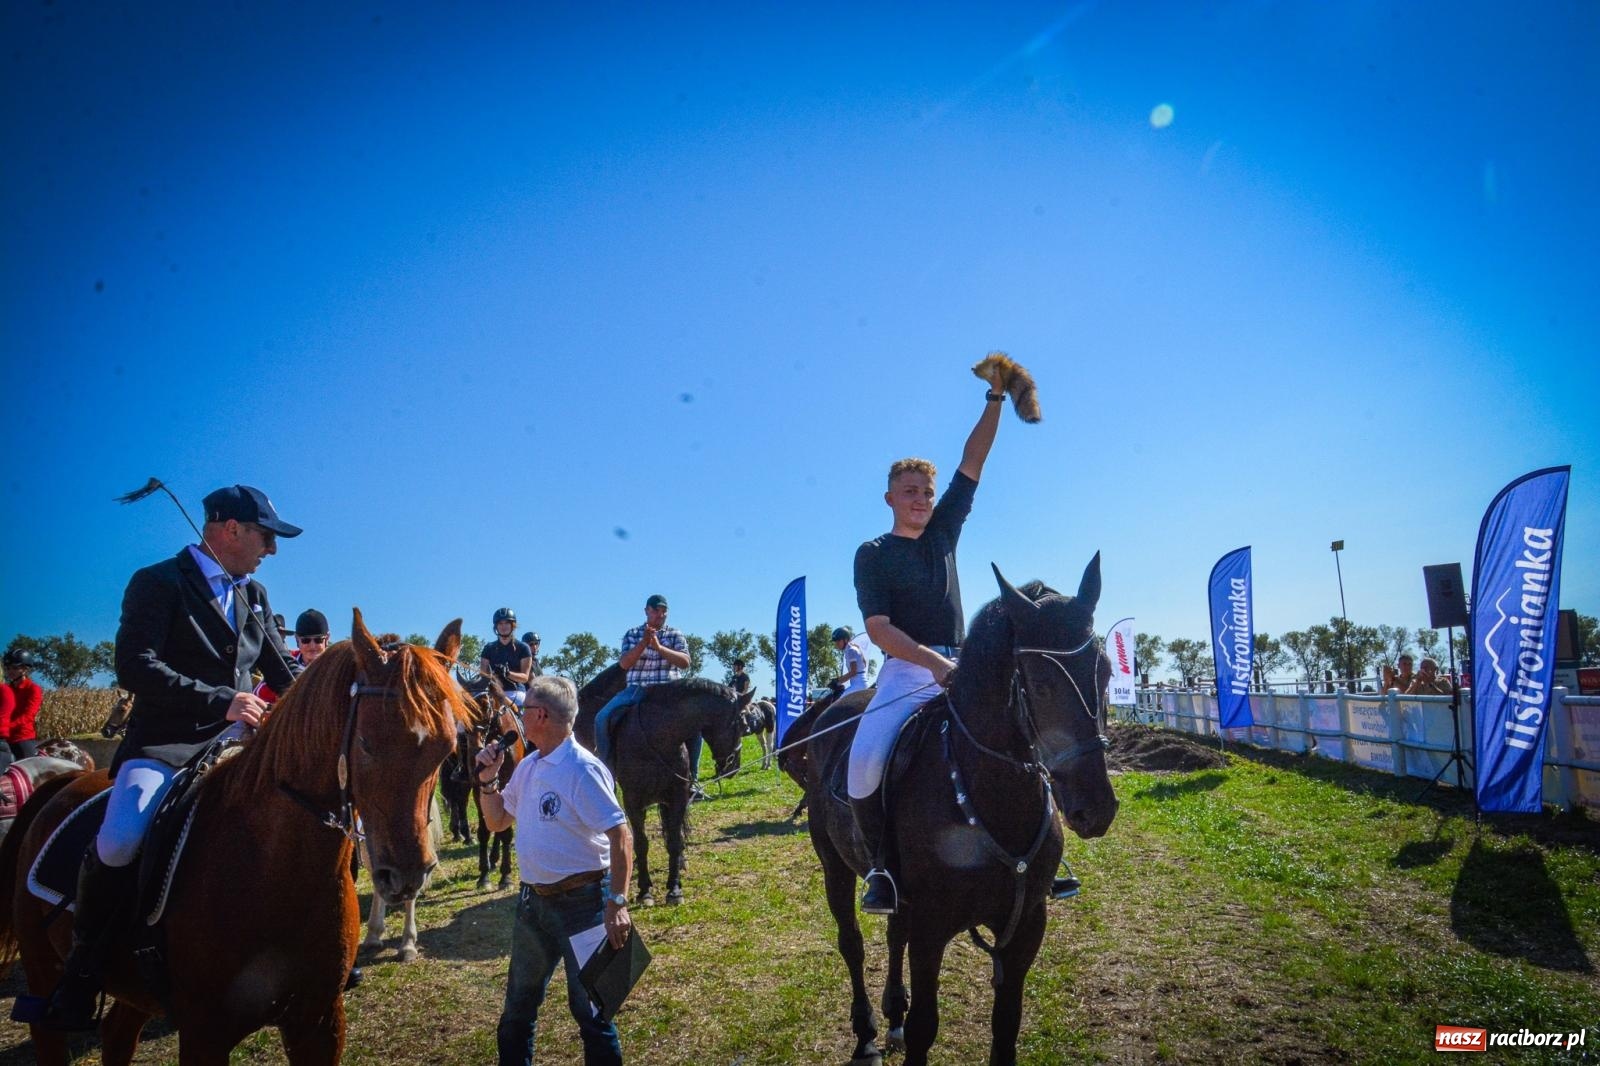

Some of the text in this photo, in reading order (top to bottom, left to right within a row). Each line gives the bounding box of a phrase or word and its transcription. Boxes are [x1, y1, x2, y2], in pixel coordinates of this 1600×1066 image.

[787, 605, 804, 718] Ustronianka
[1114, 687, 1121, 695] 30
[1228, 578, 1250, 696] Ustronianka
[1505, 526, 1554, 750] Ustronianka
